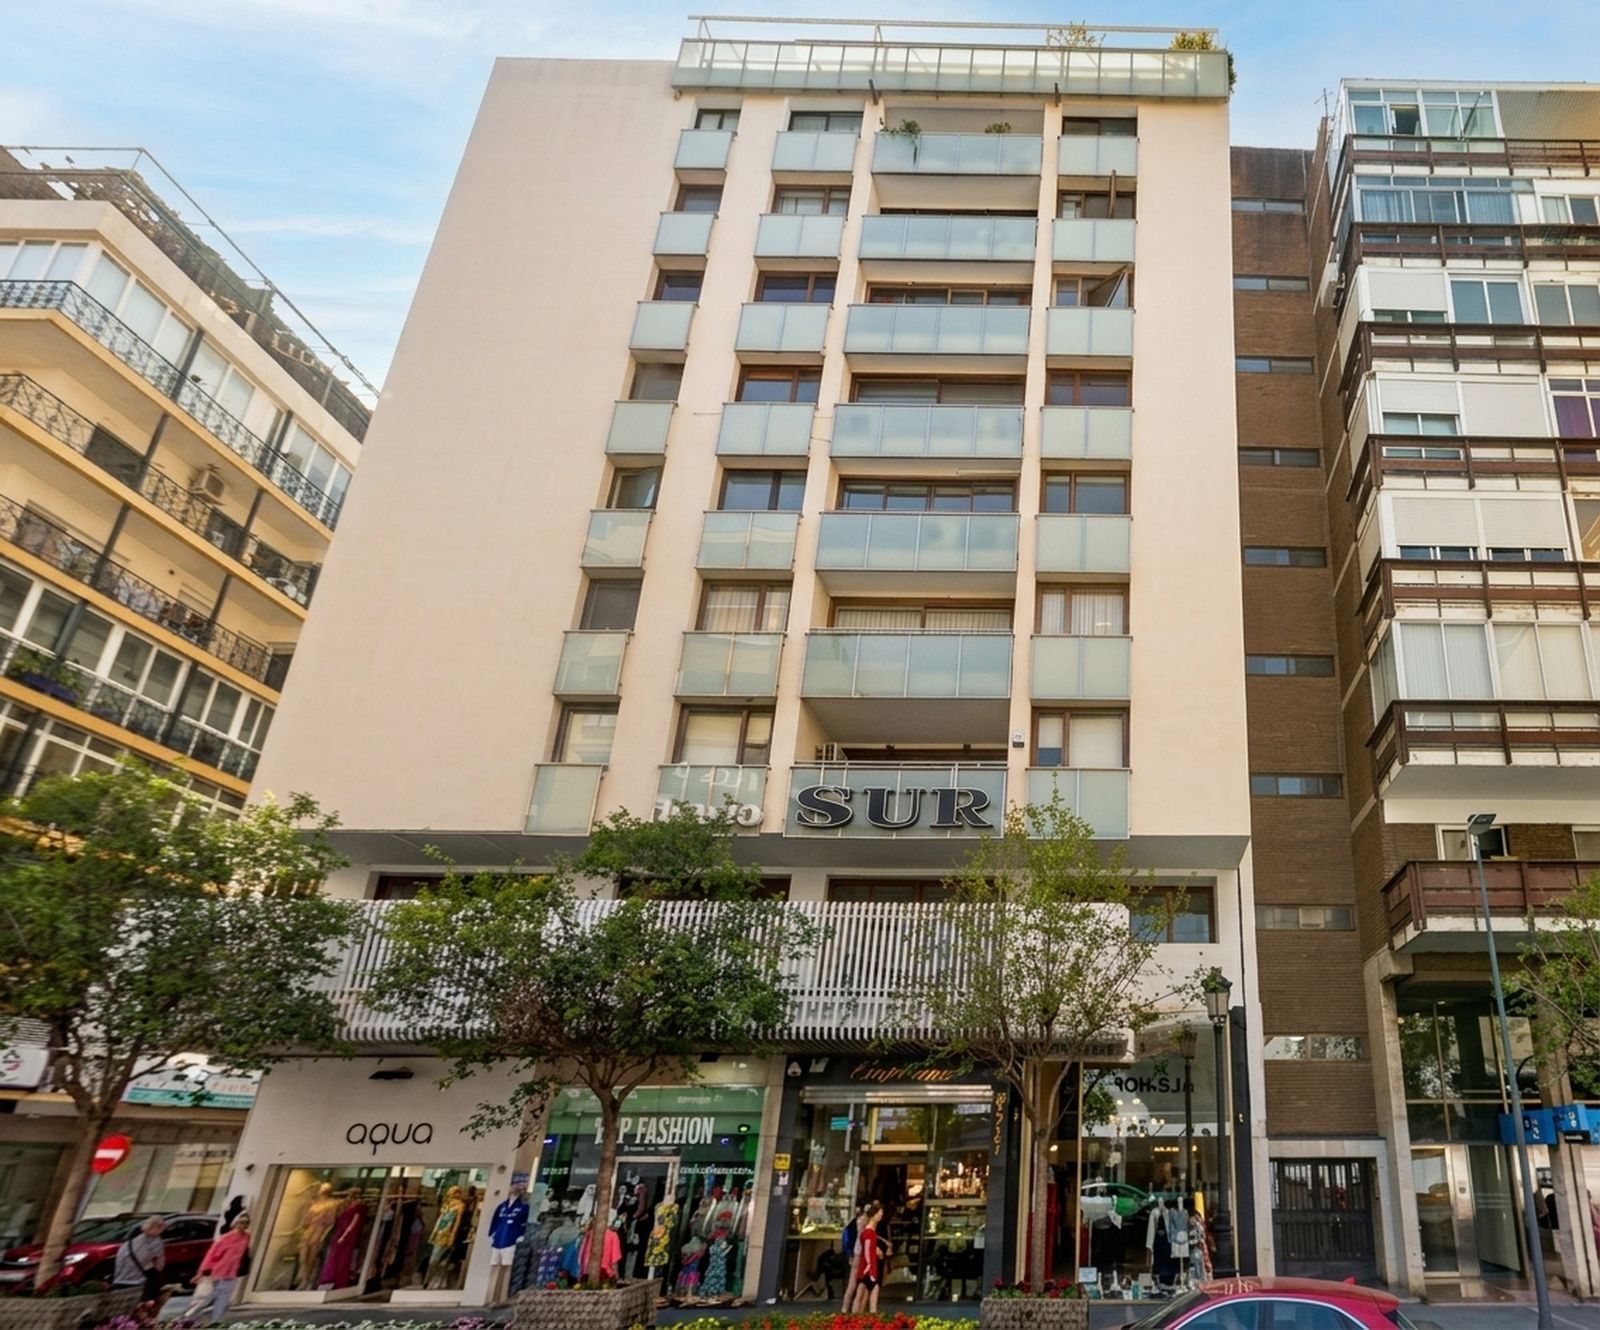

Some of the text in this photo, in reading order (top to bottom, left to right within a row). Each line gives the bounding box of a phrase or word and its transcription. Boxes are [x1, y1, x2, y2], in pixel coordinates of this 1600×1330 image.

[796, 784, 994, 829] SUR
[346, 1122, 433, 1156] aqua
[594, 1117, 716, 1145] TP FASHION
